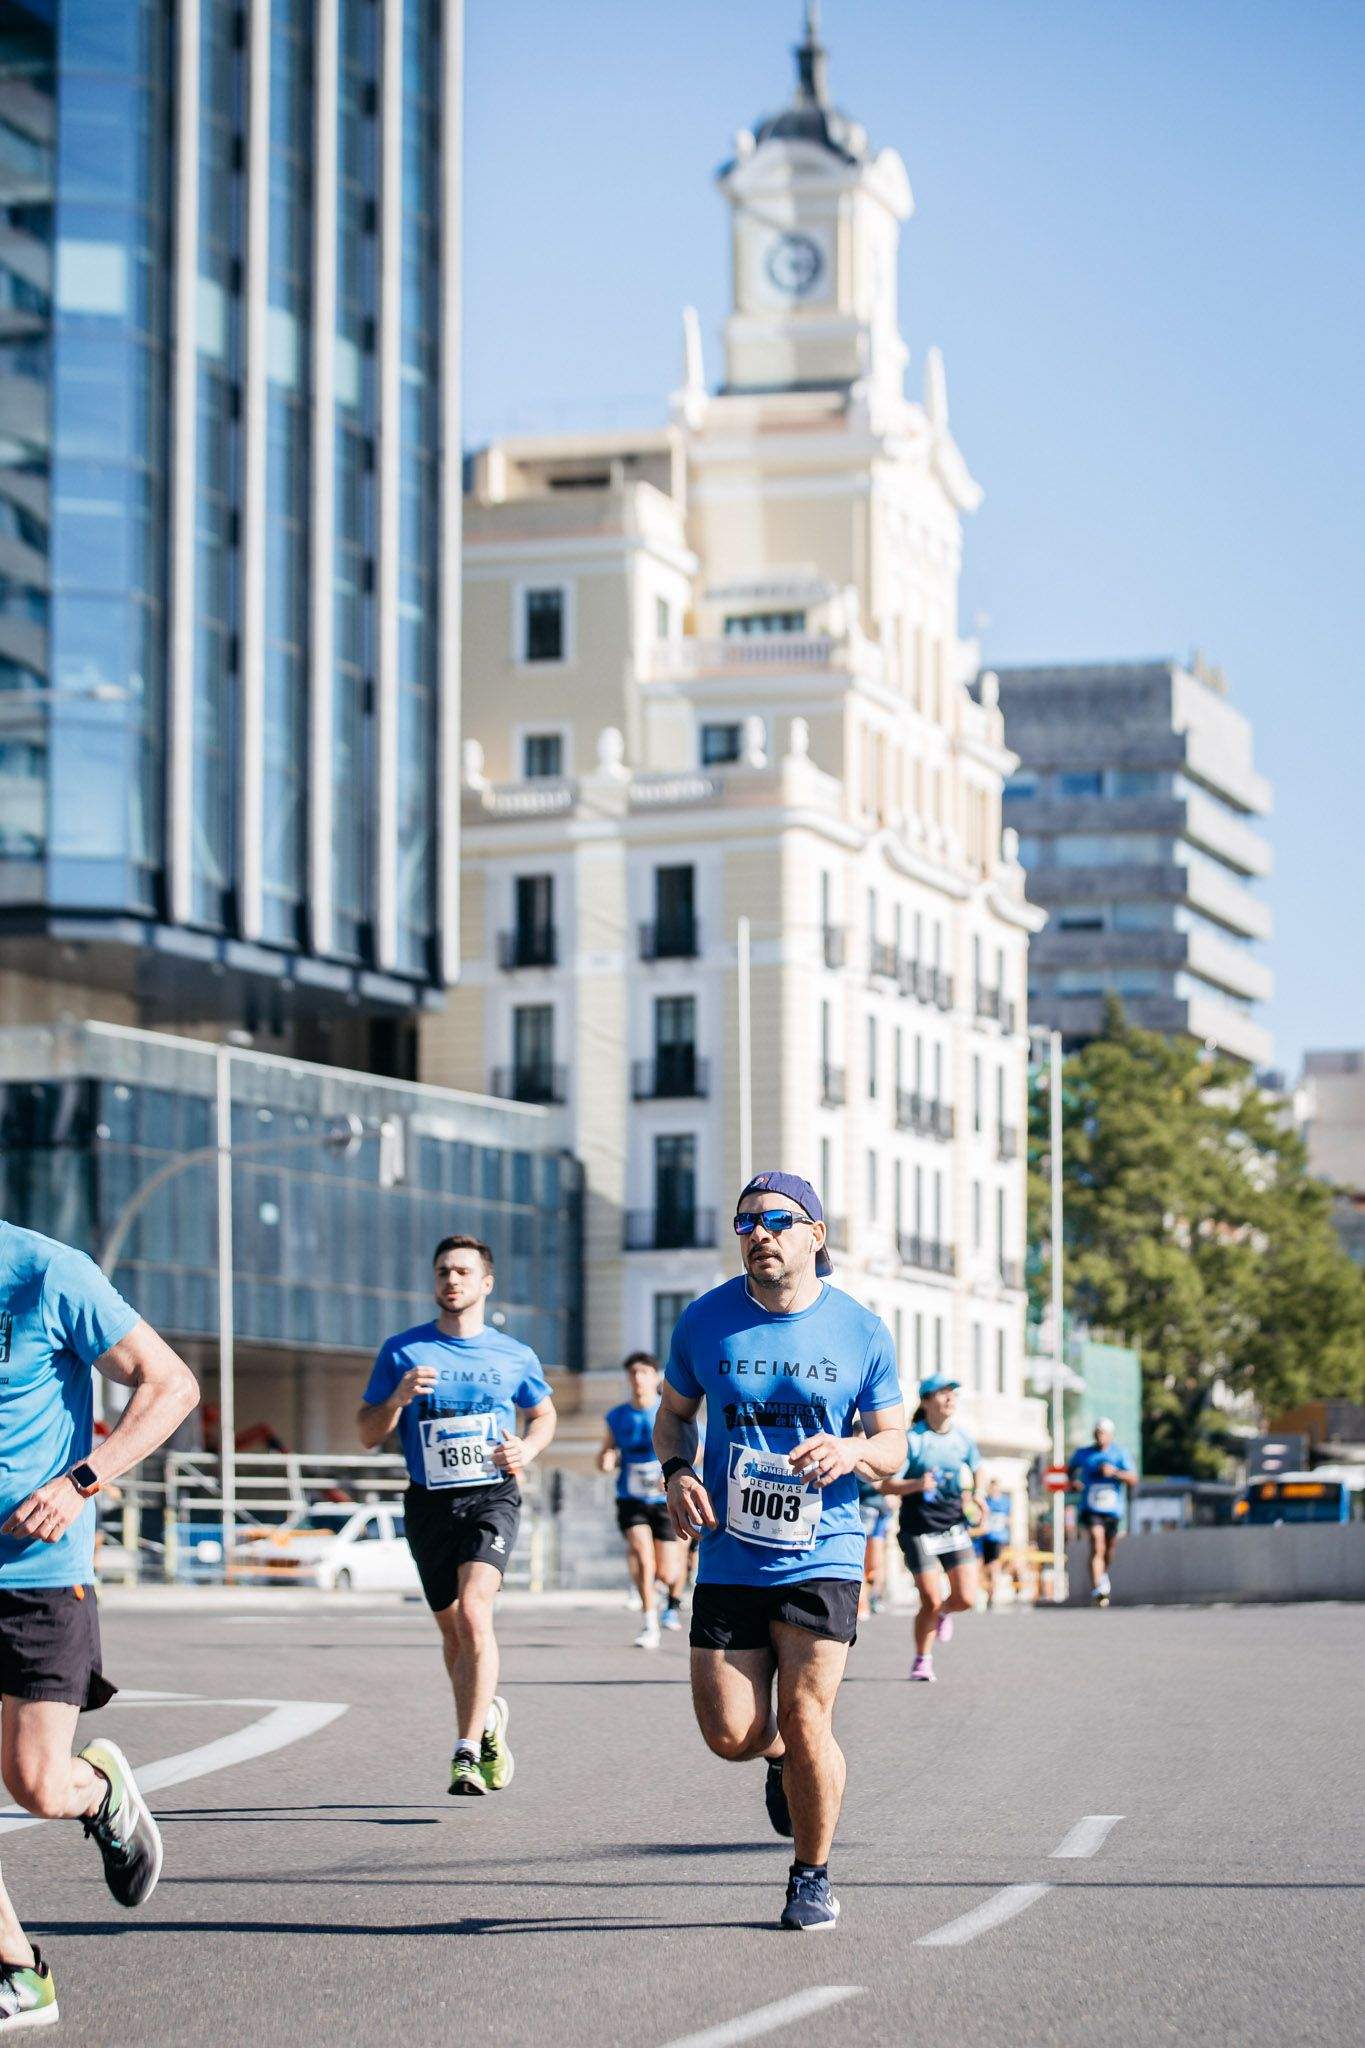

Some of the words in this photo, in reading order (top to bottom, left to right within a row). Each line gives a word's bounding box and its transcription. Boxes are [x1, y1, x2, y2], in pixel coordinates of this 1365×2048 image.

[440, 1370, 502, 1385] CIMAS
[718, 1360, 838, 1382] DECIMAS
[438, 1445, 484, 1468] 1388
[749, 1478, 802, 1493] DECIMAS
[740, 1487, 801, 1522] 1003
